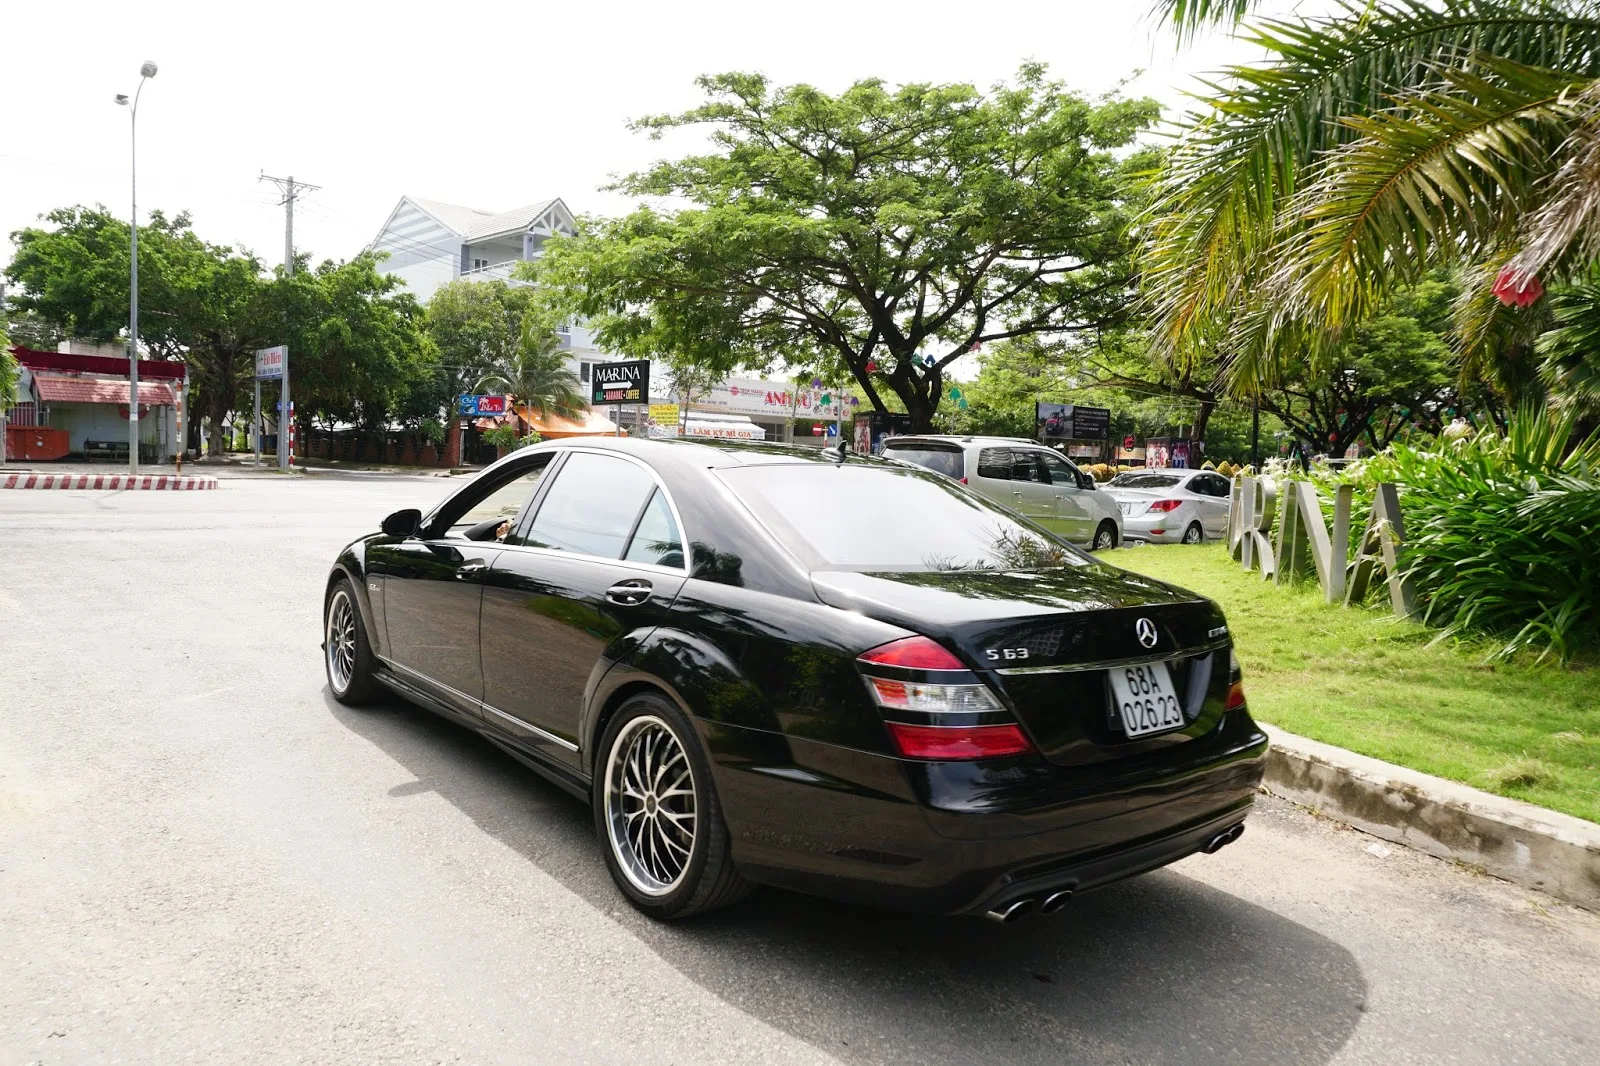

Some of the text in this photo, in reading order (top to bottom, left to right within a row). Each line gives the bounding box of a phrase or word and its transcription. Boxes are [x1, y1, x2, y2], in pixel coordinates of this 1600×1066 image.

[596, 366, 640, 382] MARINA
[606, 390, 623, 400] KARAOKE
[626, 389, 640, 399] COFFEE
[986, 647, 1029, 661] S 63
[1125, 665, 1161, 697] 68A
[1123, 696, 1181, 732] 026.23
